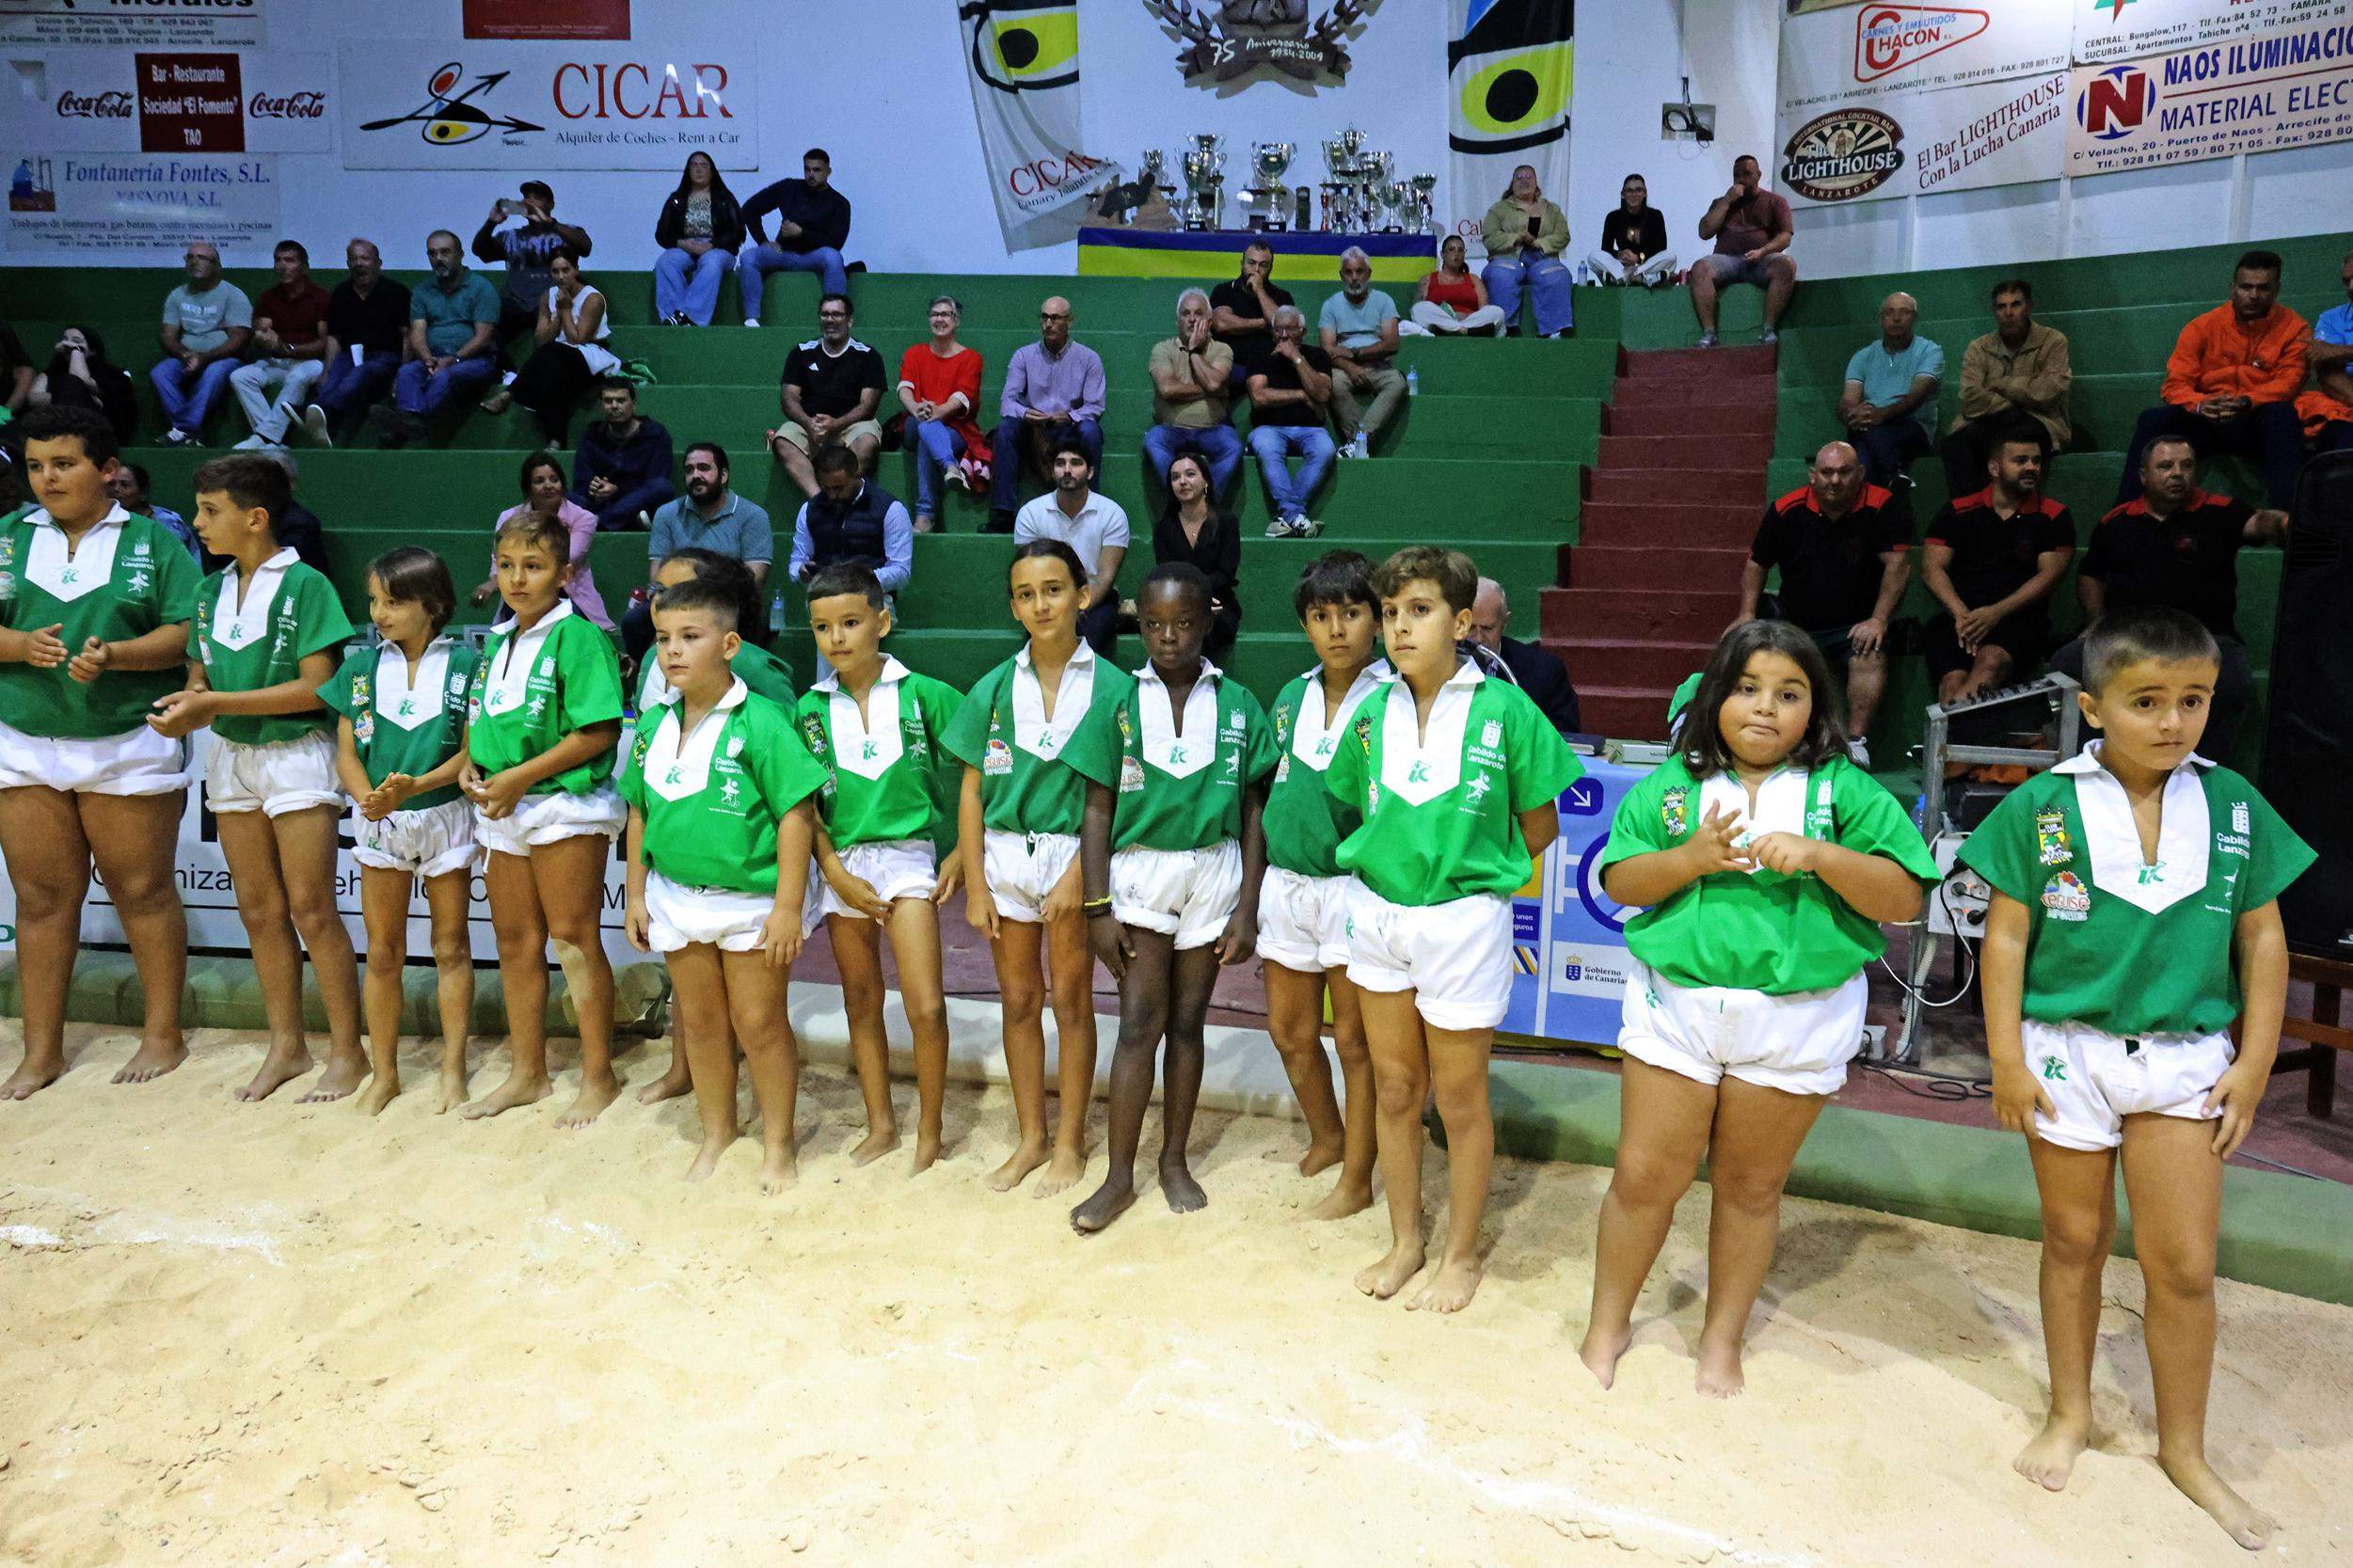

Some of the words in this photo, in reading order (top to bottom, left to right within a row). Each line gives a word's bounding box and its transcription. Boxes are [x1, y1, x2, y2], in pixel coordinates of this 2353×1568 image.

[1861, 25, 1894, 39] CARNES
[1905, 13, 1957, 30] EMBUTIDOS
[2085, 36, 2124, 48] CENTRAL:
[2250, 9, 2261, 18] 52
[2267, 7, 2277, 15] 73
[2085, 46, 2130, 59] SUCURSAL:
[2136, 35, 2193, 51] Apartamentos
[2199, 28, 2230, 40] Tahiche
[2316, 9, 2328, 19] 24
[1210, 39, 1235, 66] 75
[151, 65, 167, 83] Bar
[173, 65, 225, 83] Restaurante
[1843, 88, 1878, 98] ARRECIFE
[1884, 80, 1927, 91] LANZAROTE
[1953, 71, 1965, 81] 928
[2021, 60, 2033, 70] 928
[2051, 55, 2064, 65] 727
[2164, 49, 2220, 86] NAOS
[552, 62, 734, 119] CICAR
[2087, 72, 2146, 133] N
[56, 90, 134, 119] Coca-Cola
[144, 97, 182, 115] Sociedad
[249, 91, 325, 119] Coca-Cola
[2160, 92, 2277, 132] MATERIAL
[2288, 79, 2353, 113] ELEC
[1848, 112, 1880, 122] COCKTAIL
[1880, 119, 1896, 133] BAR
[1917, 148, 1931, 170] El
[1934, 140, 1957, 162] Bar
[1959, 74, 2065, 148] LIGHTHOUSE
[183, 129, 202, 146] TAO
[556, 131, 603, 147] Alquiler
[607, 132, 620, 144] de
[624, 133, 667, 144] Coches
[678, 132, 705, 144] Rent
[708, 135, 715, 144] a
[719, 132, 739, 144] Car
[1919, 167, 1946, 190] Con
[1948, 156, 1961, 174] la
[1963, 135, 2003, 166] Lucha
[2007, 103, 2060, 142] Canaria
[2074, 150, 2084, 160] C/
[2089, 145, 2138, 159] Velacho,
[2142, 141, 2155, 150] 20
[2168, 135, 2208, 147] Puerto
[2212, 133, 2227, 141] de
[2232, 128, 2264, 137] Naos
[2276, 117, 2330, 132] Arrecife
[2335, 114, 2351, 122] de
[2123, 156, 2143, 166] 928
[2148, 154, 2161, 164] 81
[2166, 150, 2177, 160] 07
[2185, 148, 2198, 157] 59
[2210, 145, 2224, 155] 80
[2229, 142, 2242, 150] 71
[2249, 139, 2263, 149] 05
[2276, 135, 2302, 145] Fax:
[2308, 130, 2331, 140] 928
[66, 161, 163, 182] Fontanería
[169, 162, 232, 185] Fontes,
[238, 163, 270, 182] S.L.
[1788, 150, 1898, 181] LIGHTHOUSE
[1058, 174, 1093, 198] Islands
[1802, 177, 1880, 198] LANZAROTE
[237, 221, 273, 232] piscinas
[1468, 745, 1497, 759] Cabildo
[1468, 754, 1504, 770] Lanzarote
[1584, 966, 1622, 976] Gobierno
